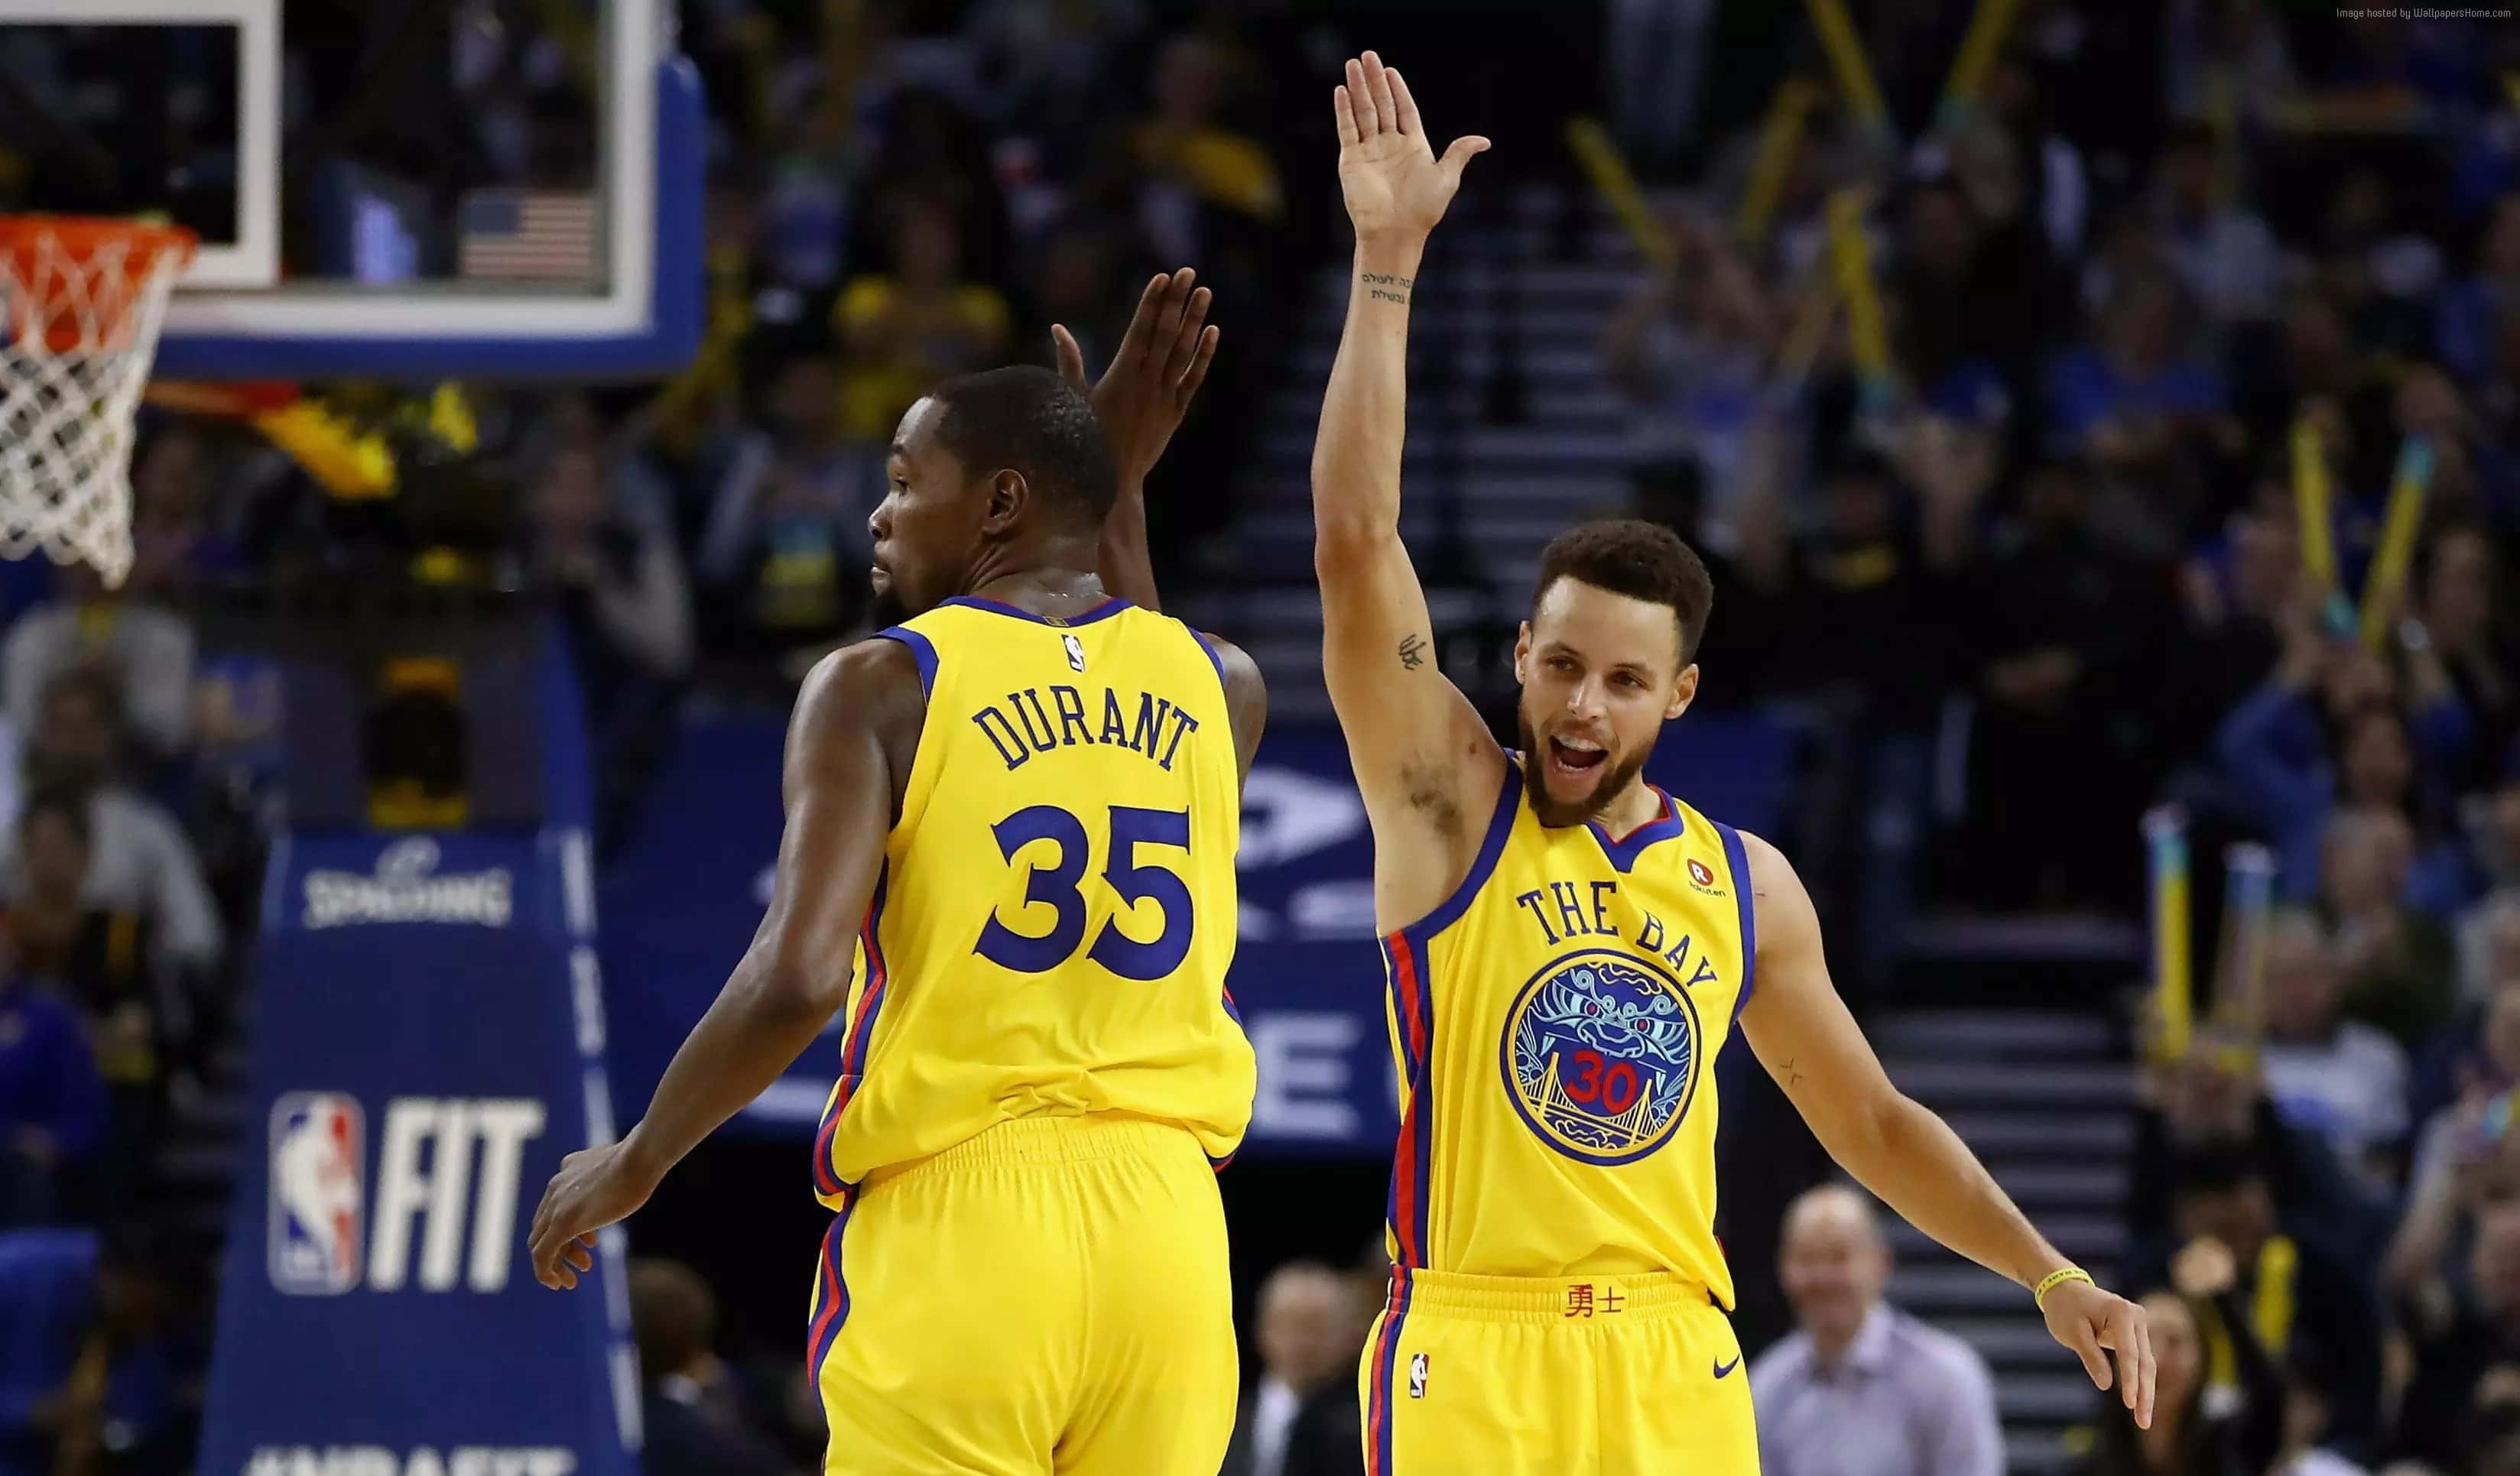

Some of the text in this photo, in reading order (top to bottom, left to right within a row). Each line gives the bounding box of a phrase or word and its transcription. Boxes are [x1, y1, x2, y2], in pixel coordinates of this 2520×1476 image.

[972, 686, 1199, 771] DURANT
[973, 805, 1194, 981] 35
[1691, 863, 1709, 883] R
[1517, 881, 1718, 988] THE BAY
[1565, 1051, 1637, 1114] 30
[368, 1096, 548, 1293] FIT
[1564, 1283, 1625, 1318] 勇士
